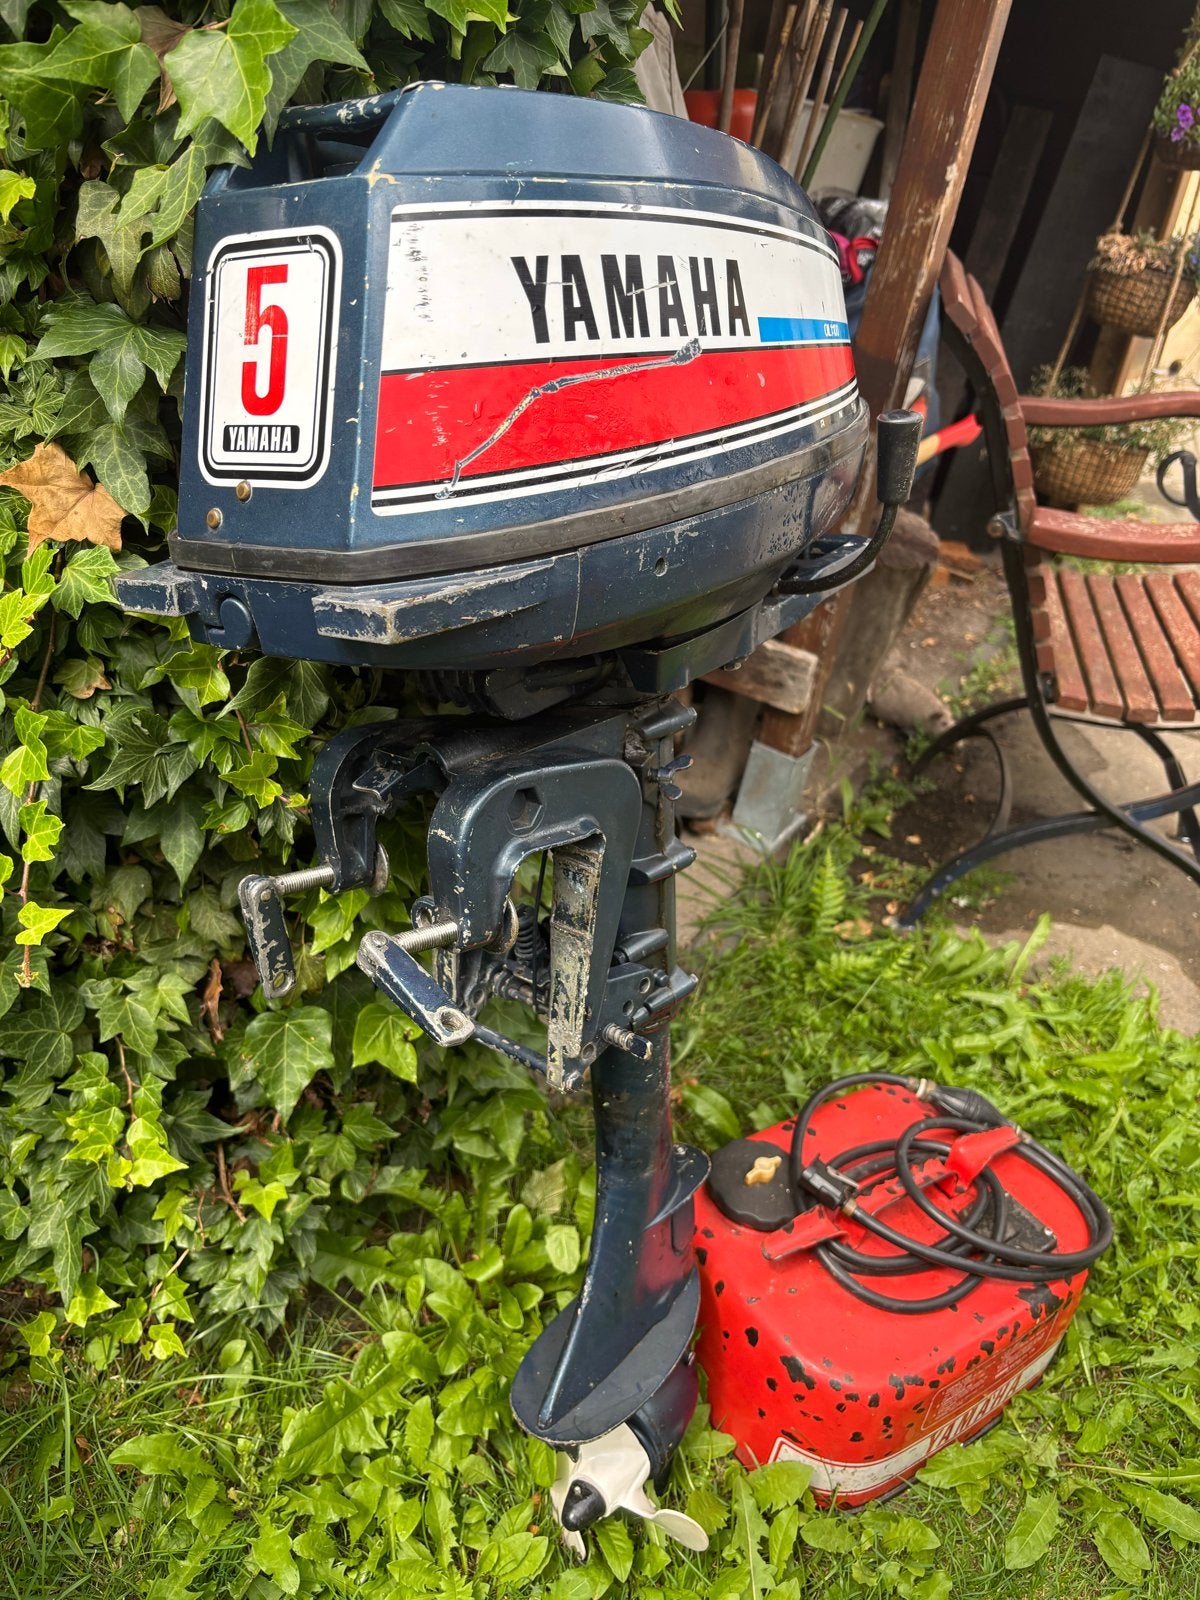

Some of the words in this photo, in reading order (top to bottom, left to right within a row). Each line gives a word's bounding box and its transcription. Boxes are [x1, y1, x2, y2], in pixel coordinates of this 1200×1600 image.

[241, 264, 288, 416] 5
[510, 254, 751, 344] YAMAHA
[229, 426, 292, 452] YAMAHA
[925, 1372, 1024, 1456] YAMAHA
